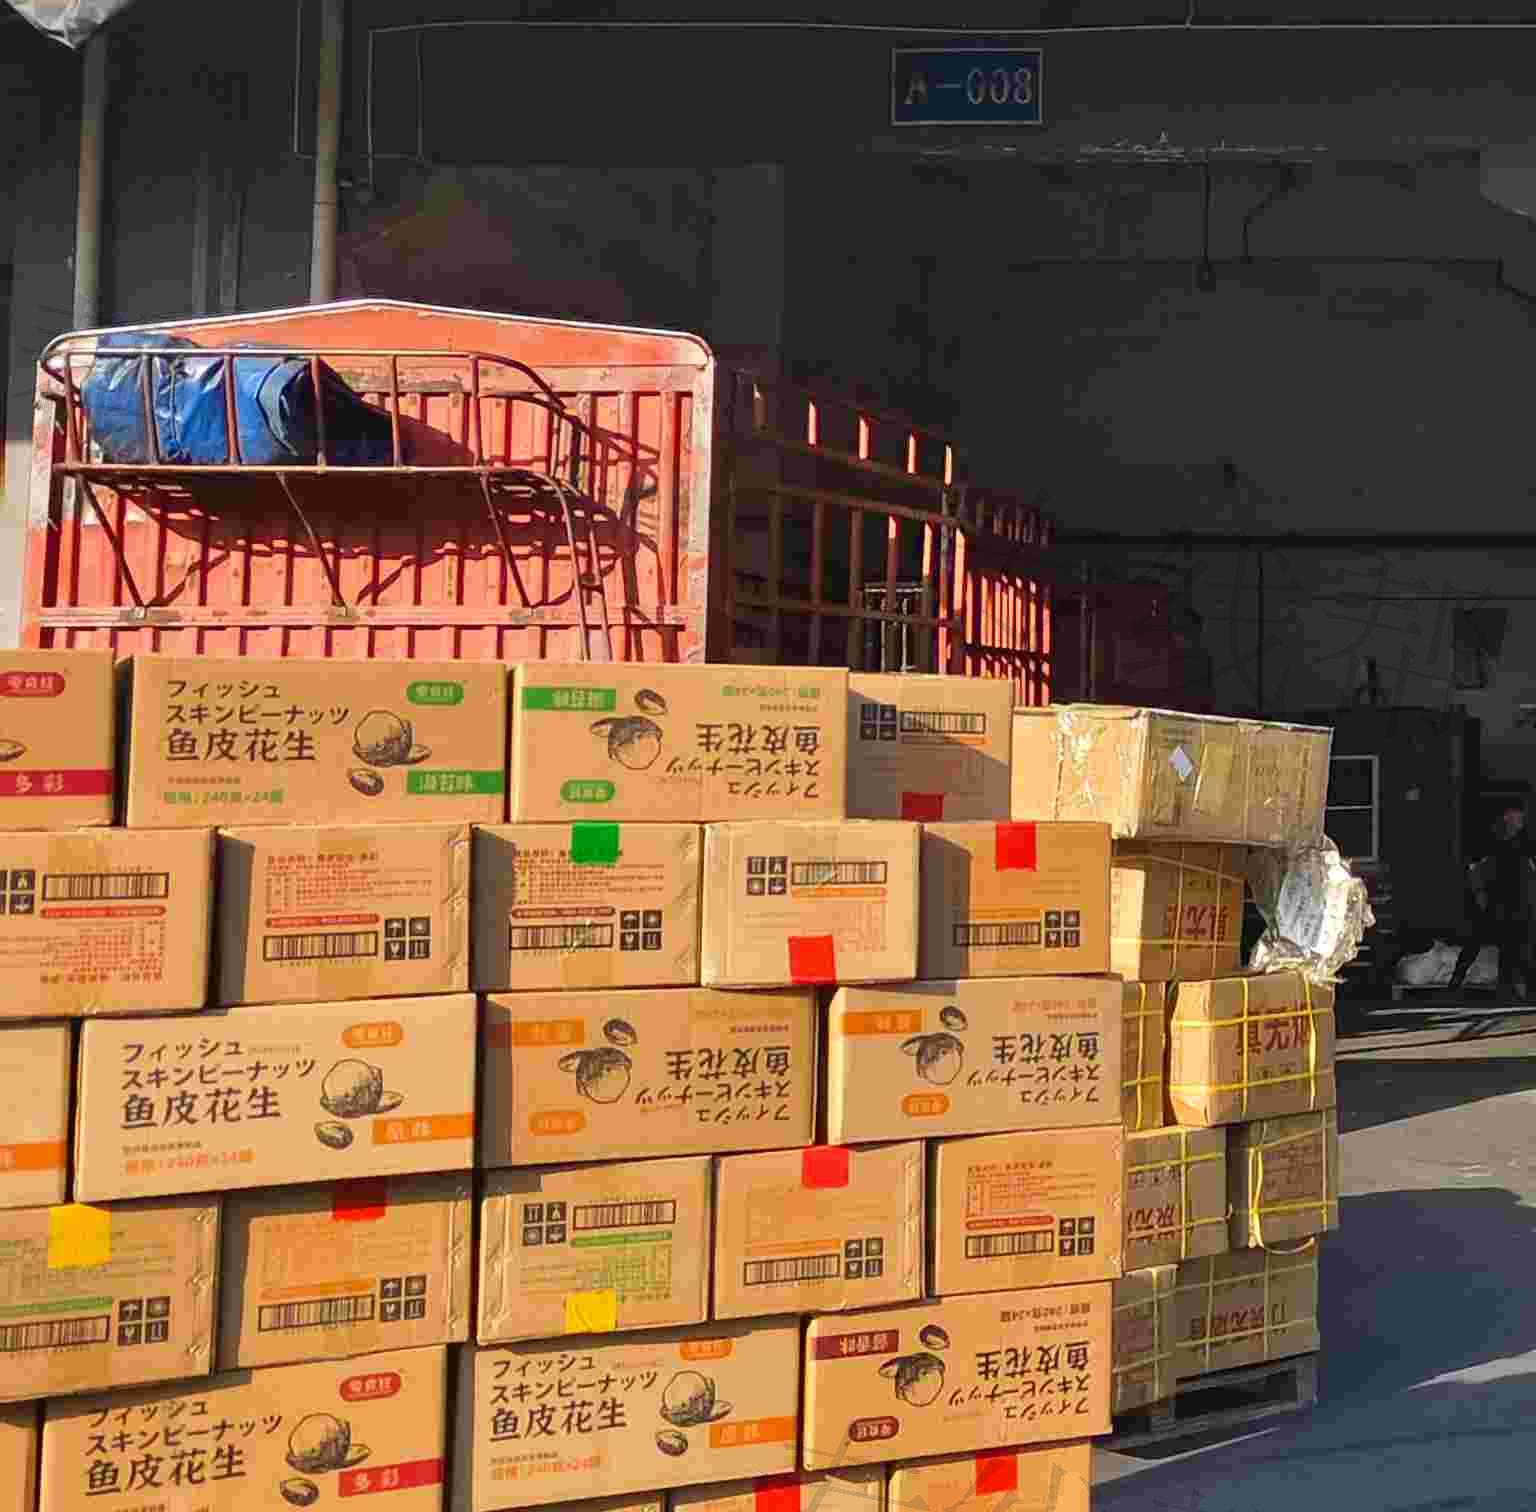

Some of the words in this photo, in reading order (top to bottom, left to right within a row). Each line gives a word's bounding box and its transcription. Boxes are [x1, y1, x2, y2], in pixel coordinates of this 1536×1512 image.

[903, 65, 1033, 105] A-008
[166, 728, 318, 762] 鱼皮花生
[696, 722, 822, 753] 鱼皮花生
[665, 1045, 791, 1080] 鱼皮花生
[992, 1027, 1100, 1066] 鱼皮花生
[120, 1087, 282, 1130] 鱼皮花生
[975, 1340, 1091, 1381] 鱼皮花生
[489, 1397, 628, 1443] 鱼皮花生
[84, 1444, 248, 1498] 鱼皮花生
